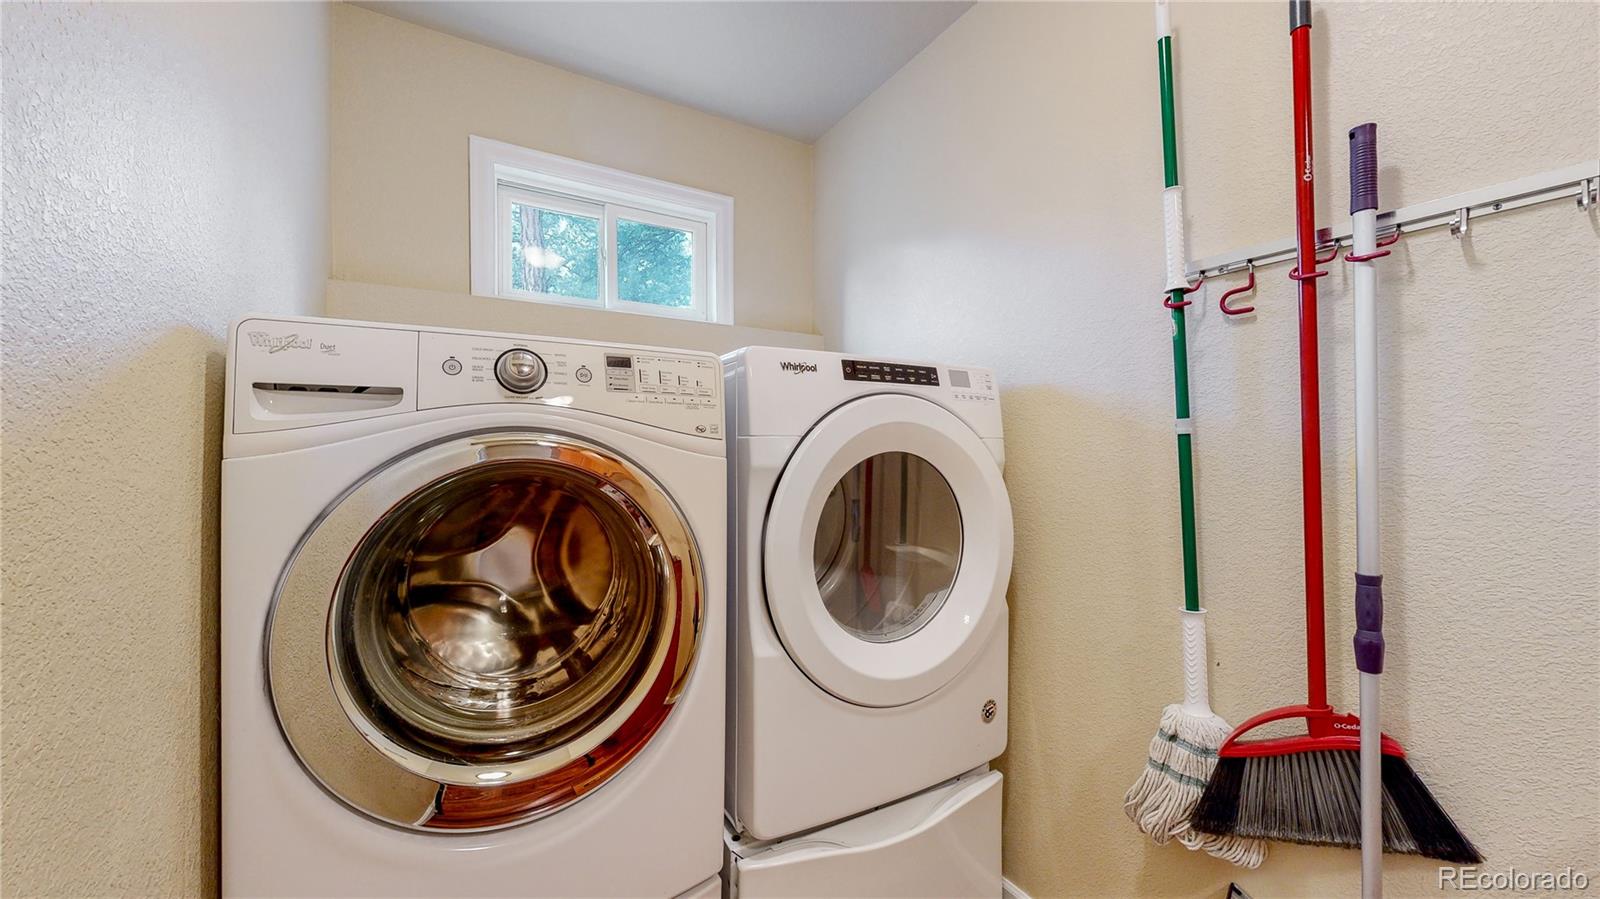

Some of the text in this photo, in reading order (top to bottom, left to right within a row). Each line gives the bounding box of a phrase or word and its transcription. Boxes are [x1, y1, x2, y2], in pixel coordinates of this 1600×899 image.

[247, 332, 313, 354] Whirlpool
[780, 361, 817, 375] Whirlpool
[1333, 722, 1360, 730] O-Ceda
